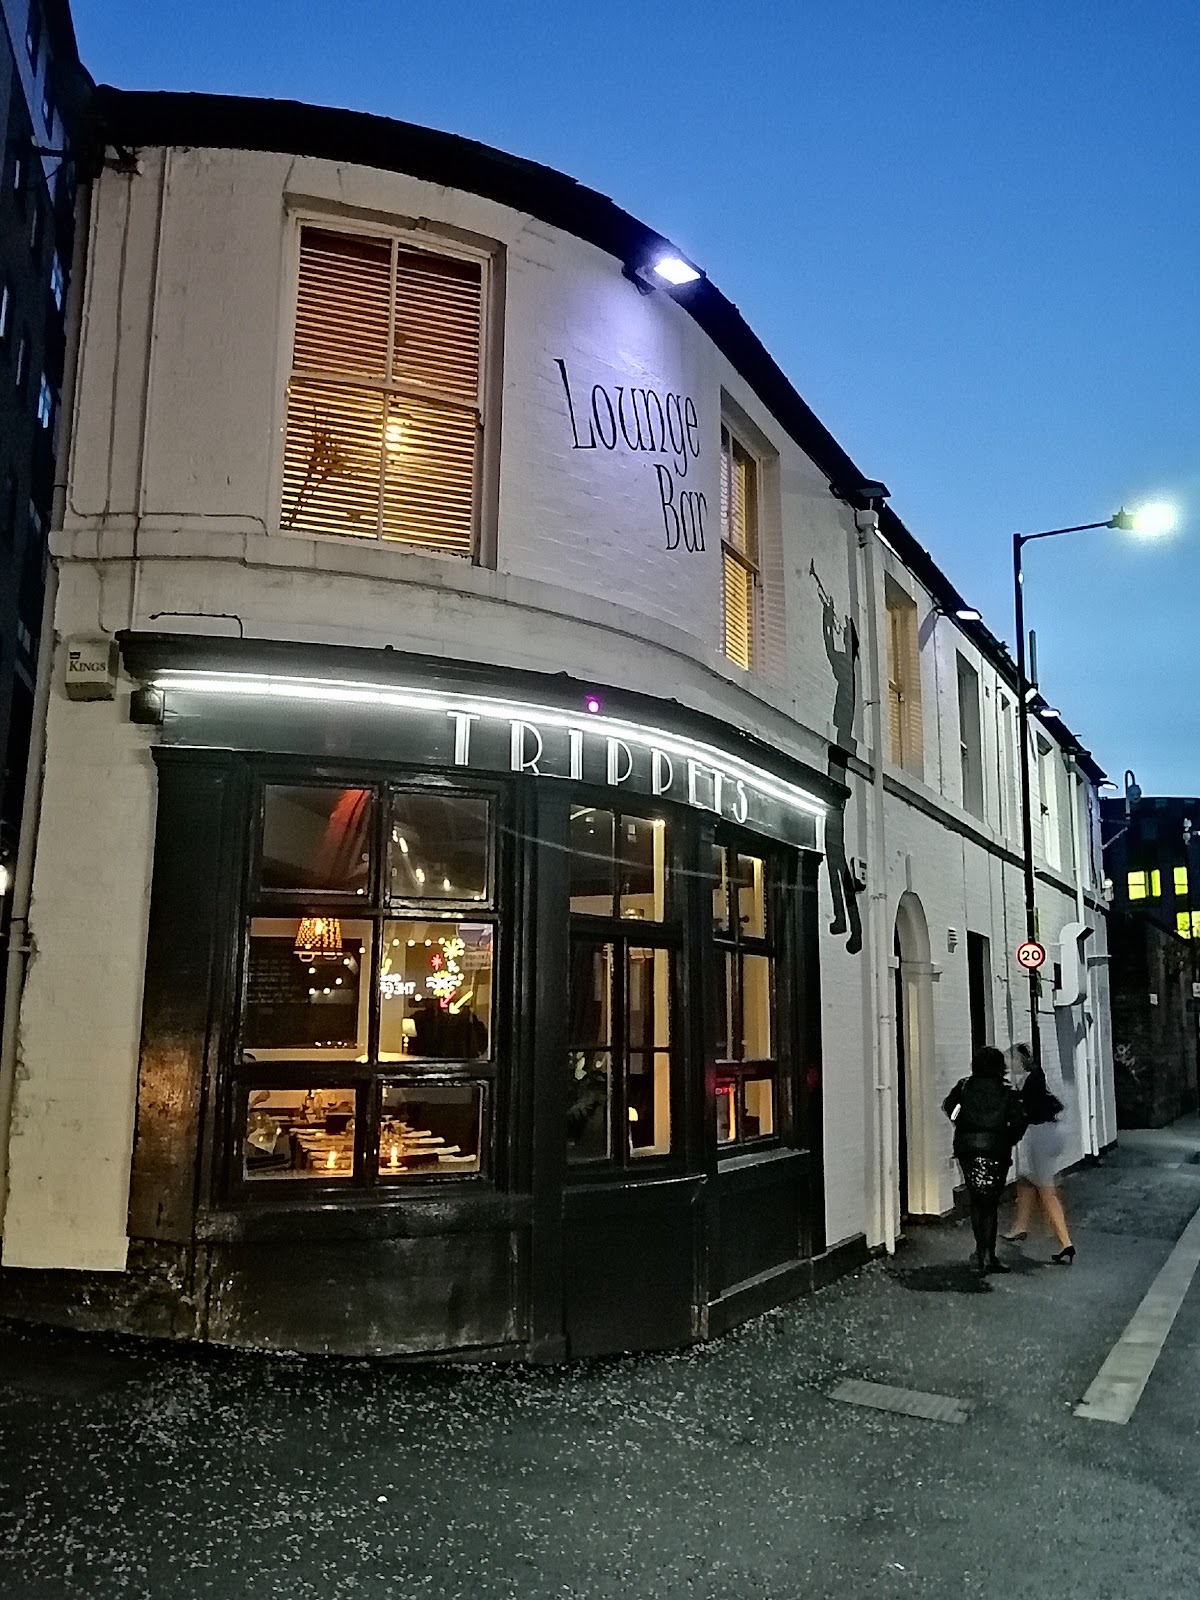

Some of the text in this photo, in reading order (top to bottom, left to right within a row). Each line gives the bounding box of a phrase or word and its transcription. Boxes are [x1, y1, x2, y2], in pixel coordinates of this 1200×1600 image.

[553, 358, 700, 478] Lounge
[653, 463, 708, 553] Bar
[446, 711, 749, 824] TRIPPETS
[1021, 950, 1041, 961] 20
